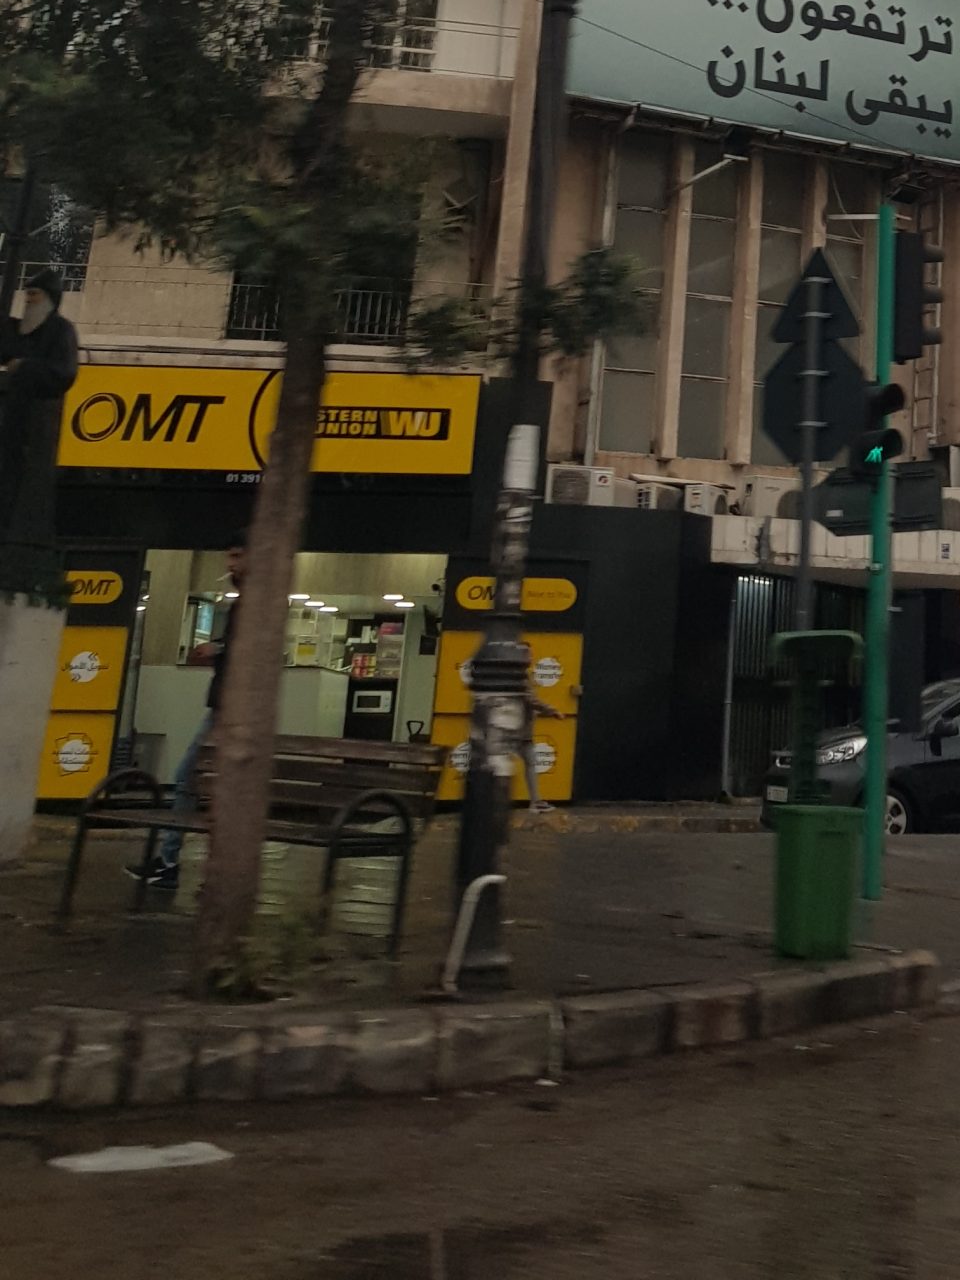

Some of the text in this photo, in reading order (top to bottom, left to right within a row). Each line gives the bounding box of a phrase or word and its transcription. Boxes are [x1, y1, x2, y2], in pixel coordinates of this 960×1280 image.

[707, 45, 953, 139] يبقى لبنان
[71, 392, 226, 443] OMT
[317, 409, 378, 422] STERN
[389, 410, 442, 437] WU
[467, 585, 496, 601] OM
